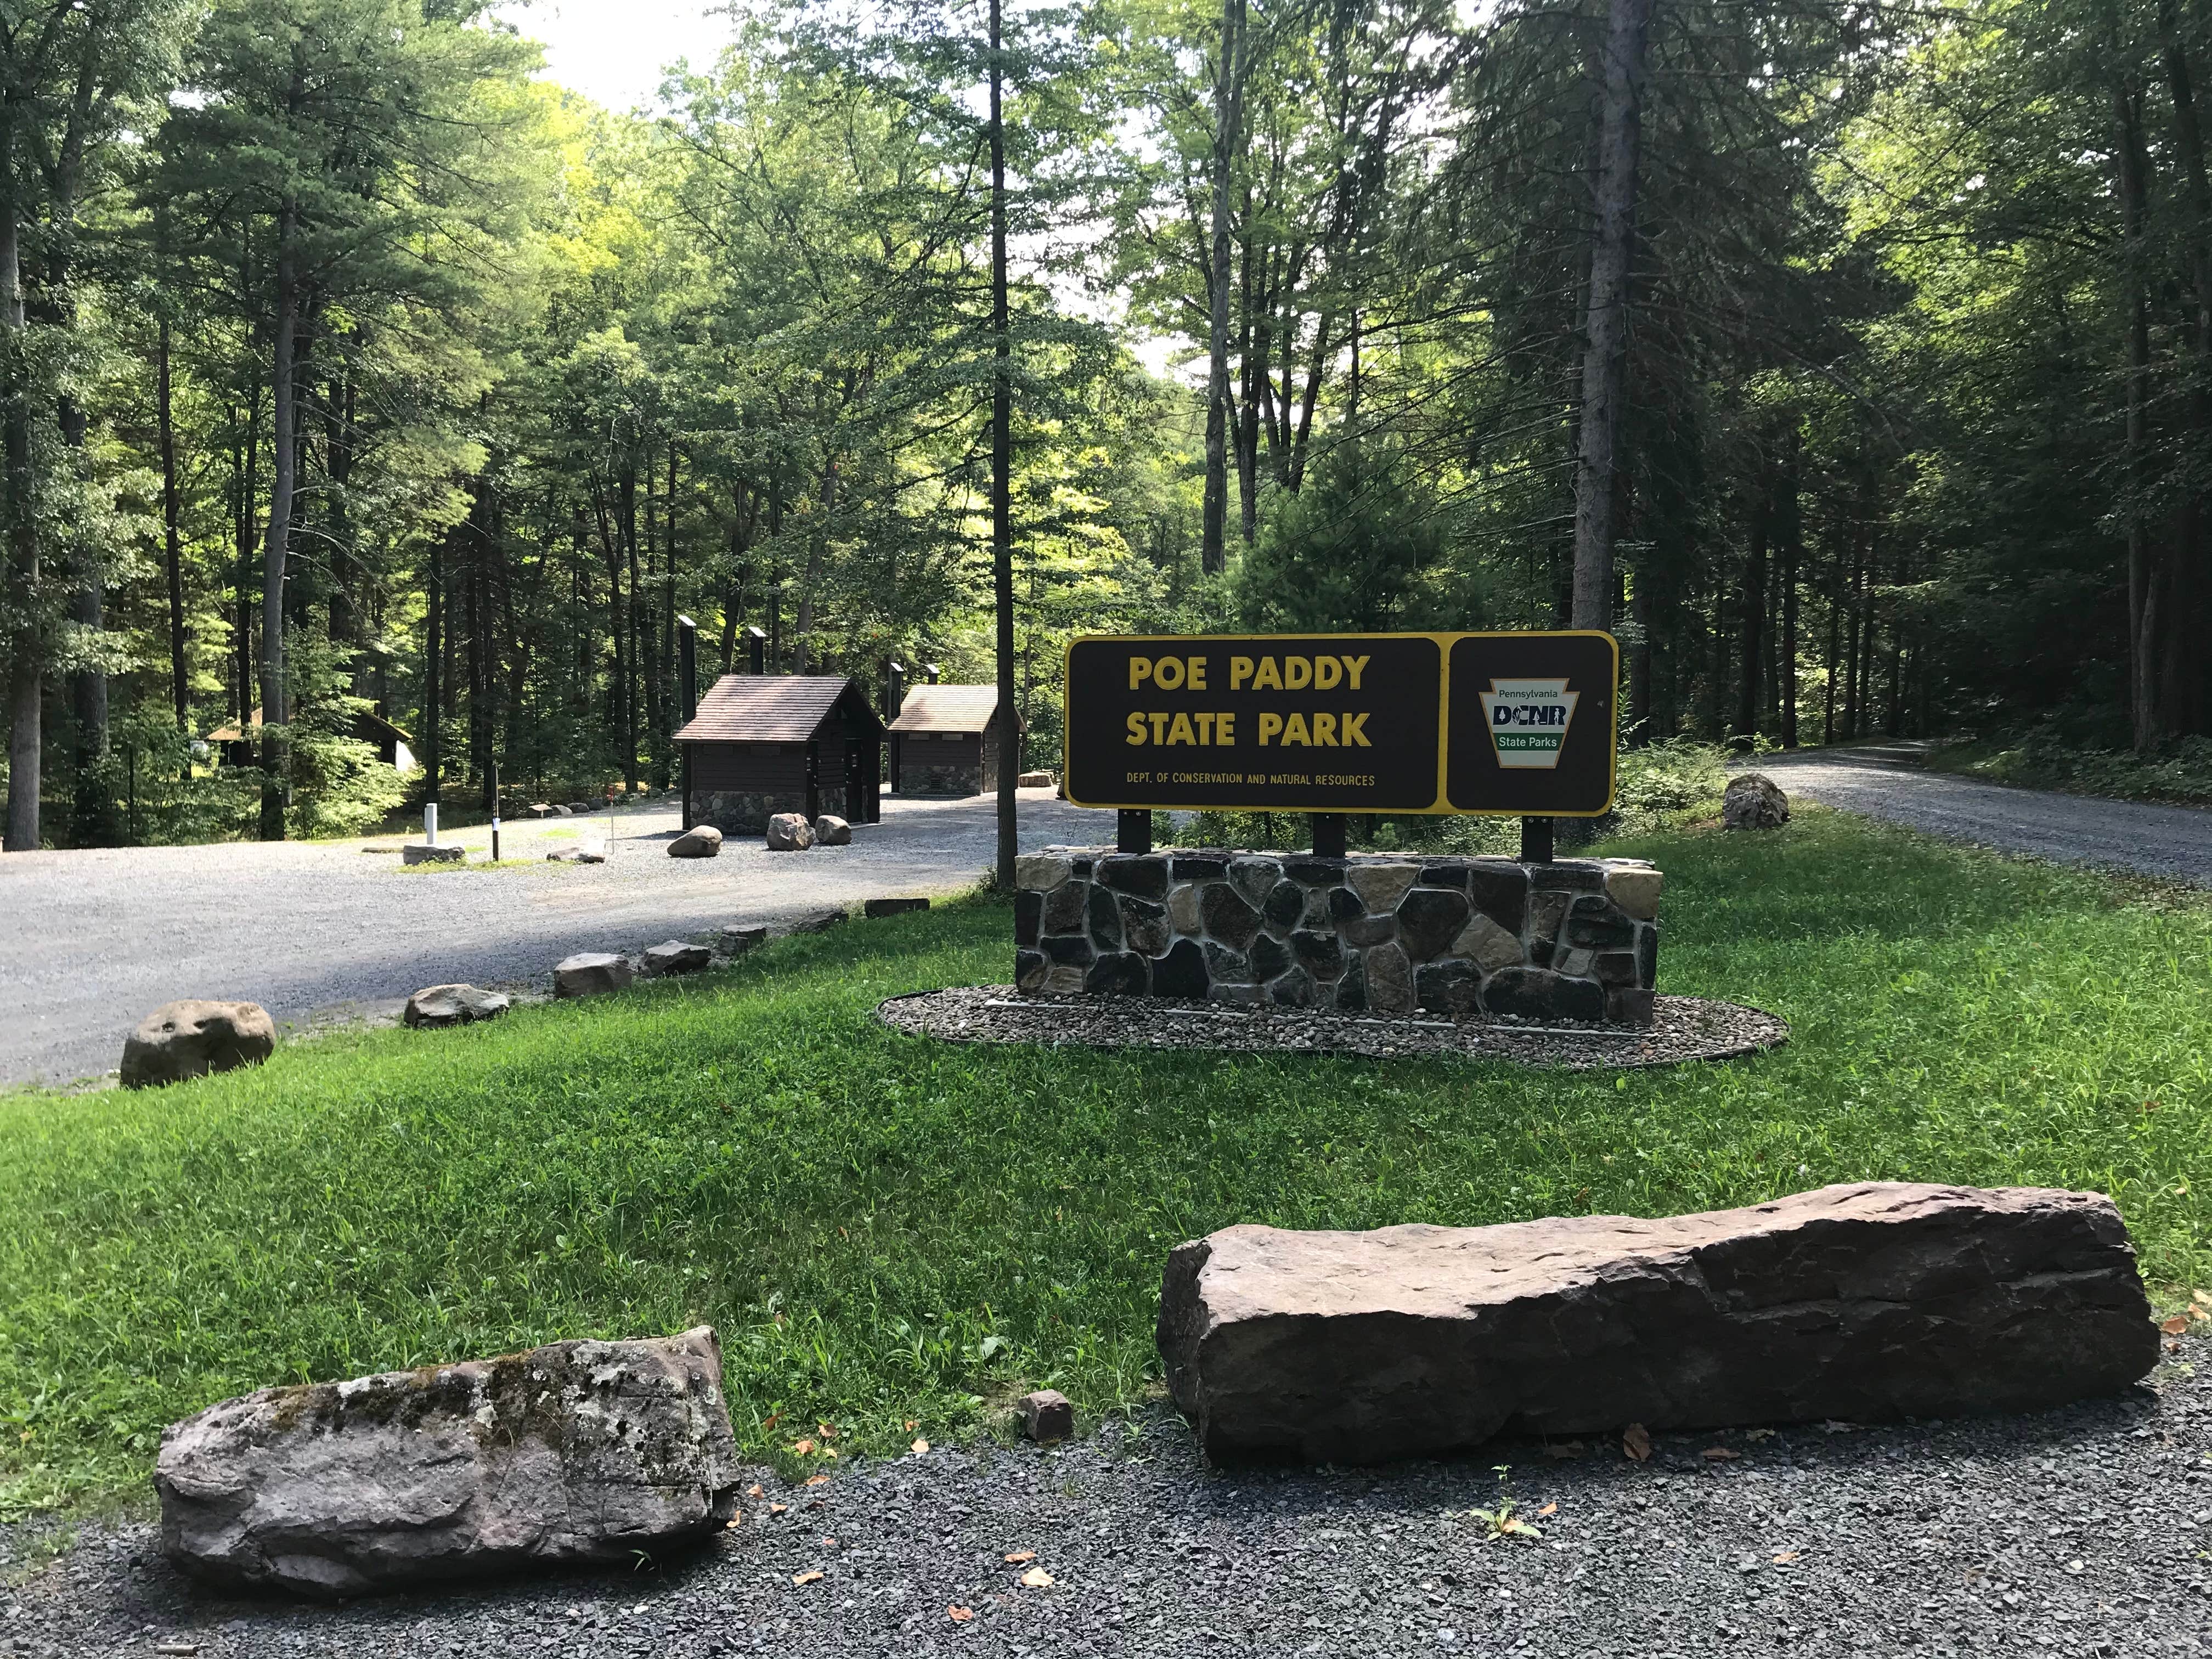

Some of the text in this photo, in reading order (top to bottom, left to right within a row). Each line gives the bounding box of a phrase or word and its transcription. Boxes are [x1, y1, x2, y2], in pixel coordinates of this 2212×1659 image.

[1129, 655, 1371, 690] POE PADDY
[1498, 689, 1558, 699] Pennsylvania
[1492, 704, 1567, 726] DCNR
[1126, 712, 1372, 747] STATE PARK
[1499, 736, 1557, 747] State Parks
[1126, 772, 1375, 786] DEPT. OF CONSERVATION AND NATURAL RESOURCES
